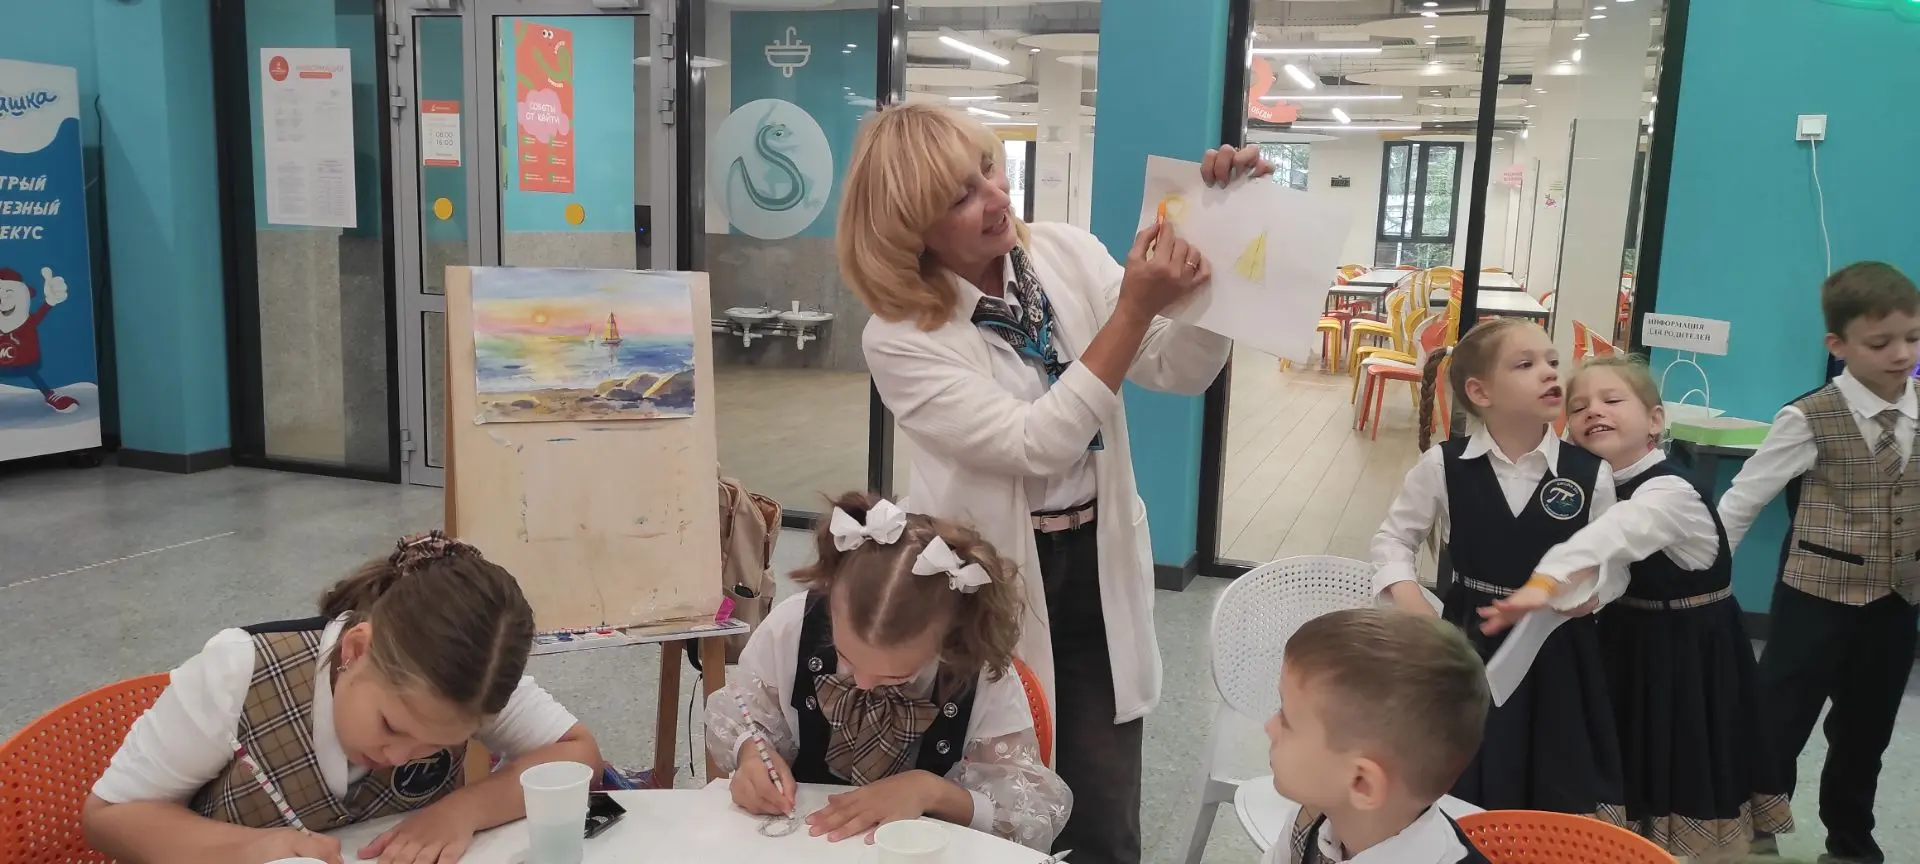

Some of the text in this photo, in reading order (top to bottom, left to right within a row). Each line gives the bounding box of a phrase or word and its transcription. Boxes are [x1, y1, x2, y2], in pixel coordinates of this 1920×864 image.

[0, 199, 60, 215] ЕЗНЫЙ
[1648, 318, 1705, 330] ИНФОРМАЦИЯ
[1664, 330, 1711, 342] РОДИТЕЛЕЙ
